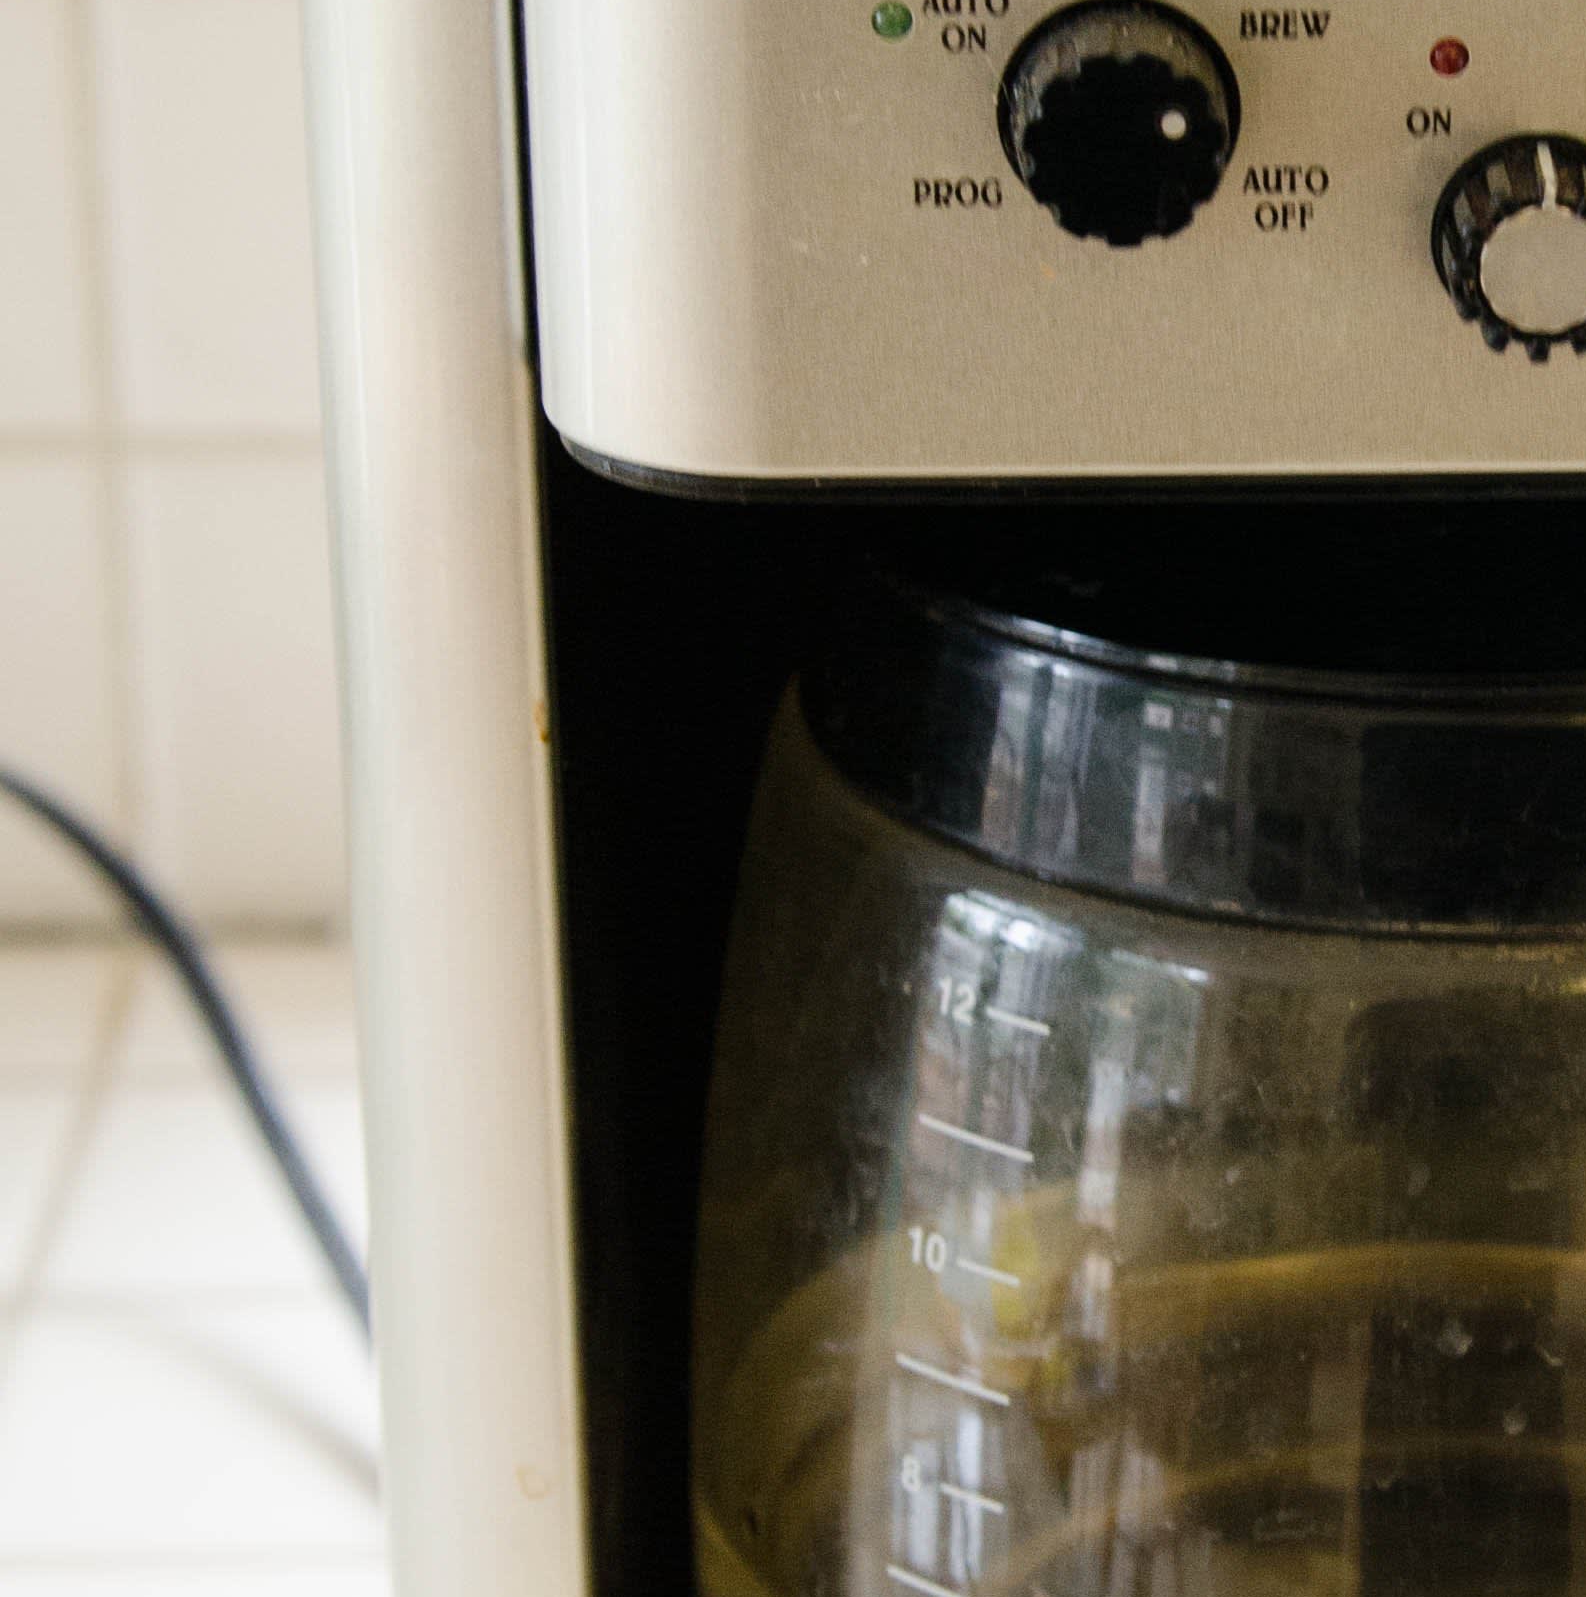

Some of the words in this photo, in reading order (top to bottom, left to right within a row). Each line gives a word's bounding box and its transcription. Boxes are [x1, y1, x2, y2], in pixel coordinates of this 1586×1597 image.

[941, 23, 988, 53] ON
[1239, 10, 1331, 40] BREW
[1406, 107, 1453, 136] ON
[912, 178, 1003, 208] PROG
[1242, 166, 1330, 195] AUTO
[1254, 203, 1315, 231] OFF
[937, 976, 976, 1026] 12
[909, 1225, 947, 1272] 10
